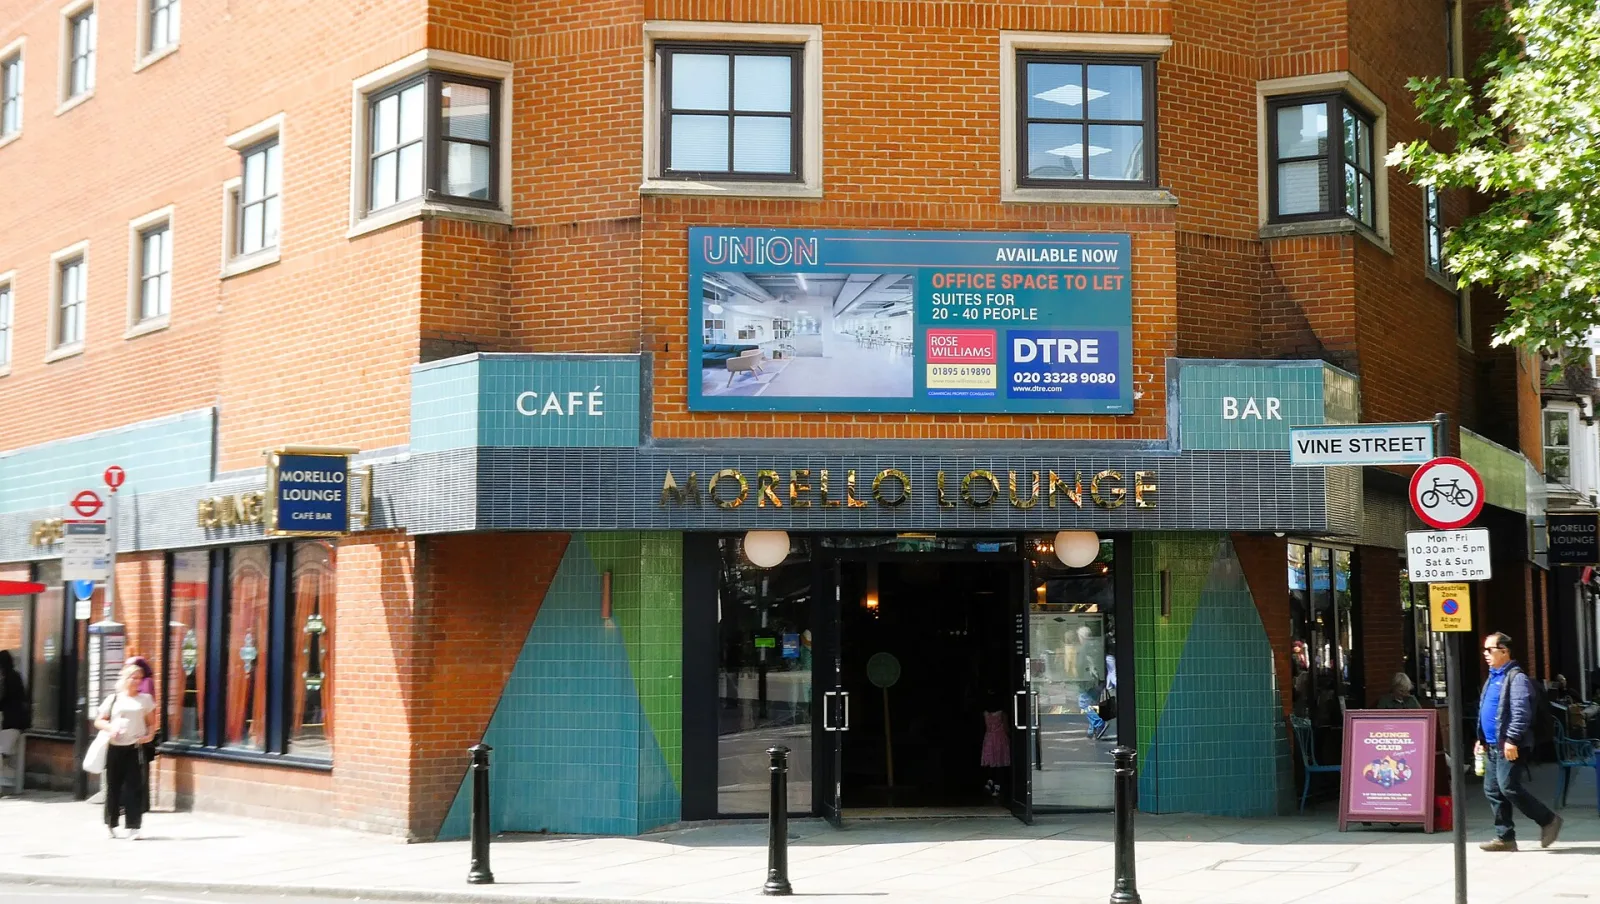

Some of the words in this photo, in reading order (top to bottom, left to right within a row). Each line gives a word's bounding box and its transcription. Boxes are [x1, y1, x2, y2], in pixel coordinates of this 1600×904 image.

[703, 236, 818, 266] UNION
[996, 248, 1078, 263] AVAILABLE
[1081, 249, 1118, 263] NOW
[932, 273, 996, 289] OFFICE
[1001, 274, 1058, 290] SPACE
[1063, 275, 1087, 290] TO
[1092, 275, 1125, 291] LET
[932, 293, 982, 306] SUITES
[986, 293, 1015, 306] FOR
[932, 308, 949, 320] 20
[962, 308, 979, 320] 40
[983, 308, 1038, 321] PEOPLE
[930, 336, 959, 347] ROSE
[931, 347, 992, 357] WILLIAMS
[1013, 338, 1099, 364] DTRE
[932, 367, 958, 376] 01895
[960, 367, 992, 376] 619890
[1013, 372, 1041, 384] 020
[1043, 372, 1078, 384] 3328
[1080, 372, 1116, 384] 9080
[516, 386, 605, 416] CAFÉ
[1223, 396, 1283, 420] BAR
[1297, 439, 1343, 454] VINE
[1349, 437, 1426, 453] STREET
[280, 470, 345, 483] MORELLO
[659, 468, 912, 508] MORELLO
[937, 468, 1157, 508] LOUNGE
[283, 489, 342, 502] LOUNGE
[291, 510, 314, 520] CAFÉ
[316, 512, 333, 520] BAR
[1551, 524, 1596, 533] MORELLO
[1427, 535, 1447, 543] Mon
[1455, 534, 1468, 542] Fri
[1553, 536, 1595, 544] LOUNGE
[1411, 546, 1439, 554] 10.30
[1471, 545, 1486, 553] pm
[1425, 558, 1442, 566] Sat
[1455, 557, 1474, 565] Sun
[1415, 569, 1438, 578] 9.30
[1462, 568, 1467, 576] 5
[1470, 569, 1484, 577] pm
